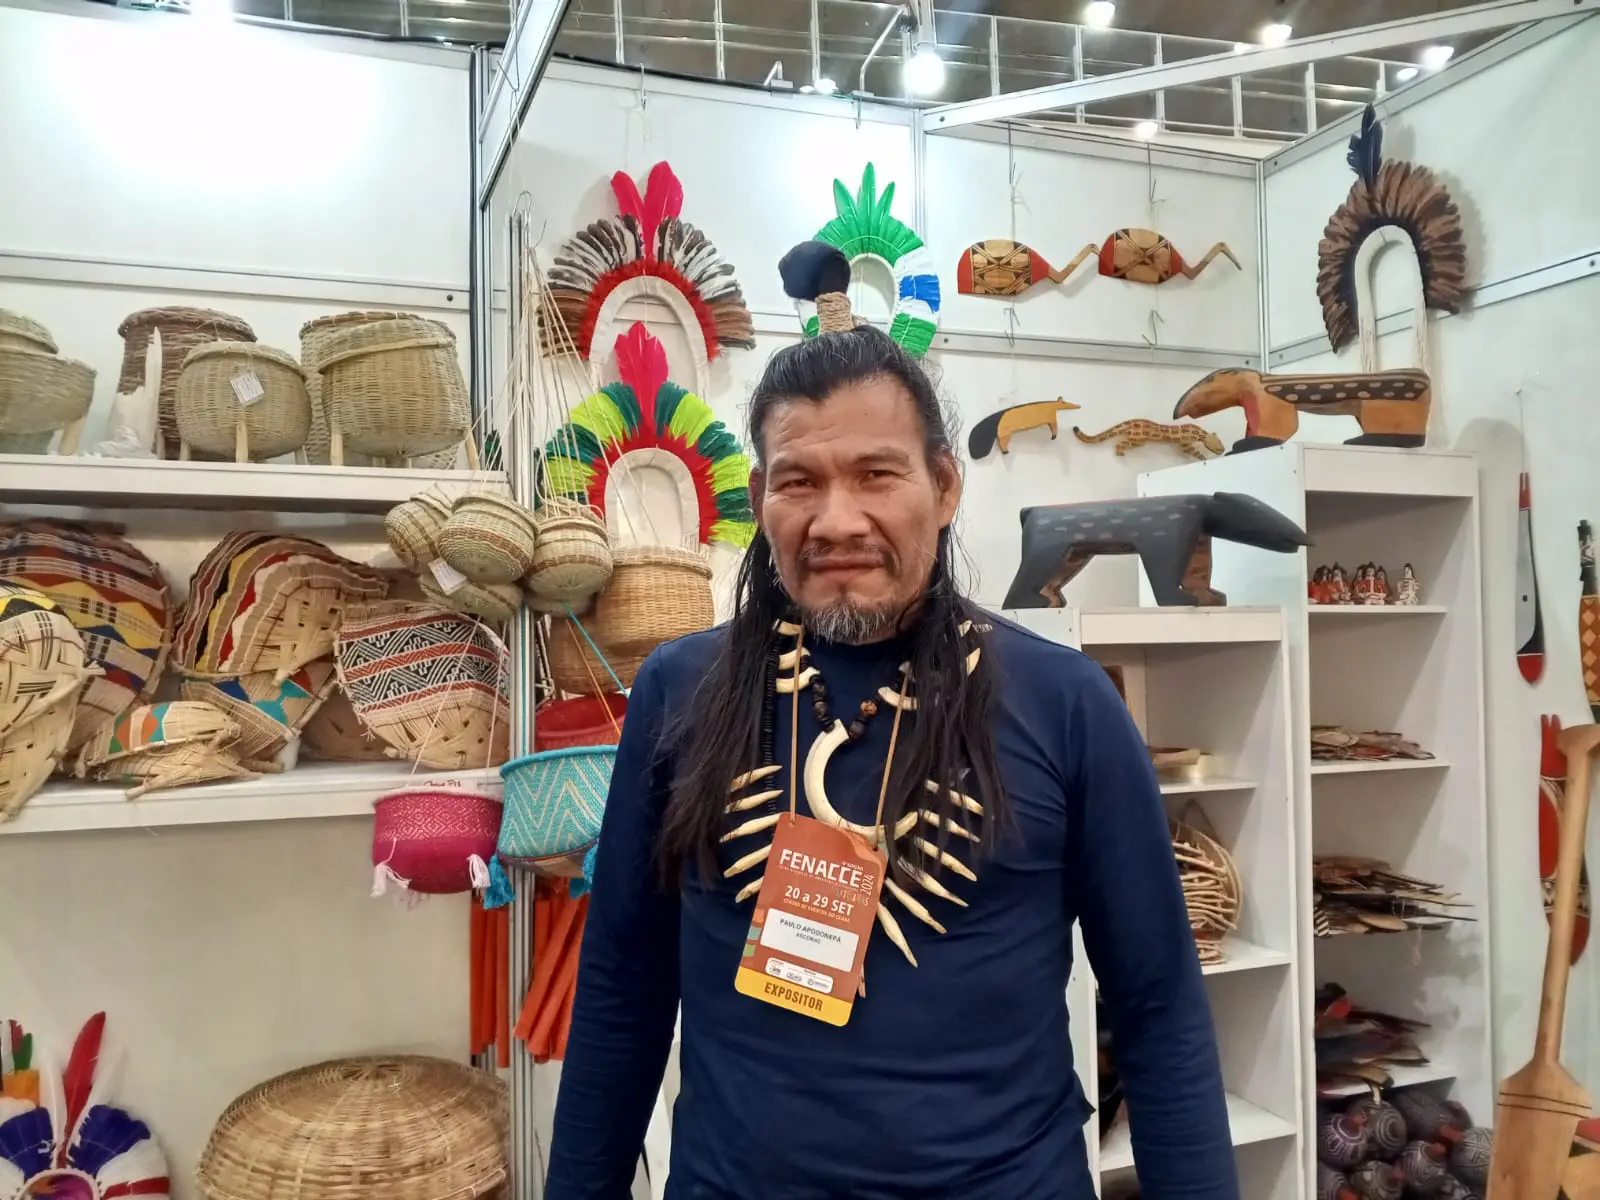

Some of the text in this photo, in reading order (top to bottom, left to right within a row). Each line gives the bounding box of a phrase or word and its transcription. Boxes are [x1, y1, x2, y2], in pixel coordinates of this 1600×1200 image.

[780, 848, 862, 888] FENACCE
[861, 873, 875, 896] 2024
[785, 884, 800, 899] 20
[802, 893, 810, 903] a
[813, 894, 829, 908] 29
[831, 899, 854, 916] SET
[780, 918, 802, 930] PAULO
[764, 982, 823, 1012] EXPOSITOR
